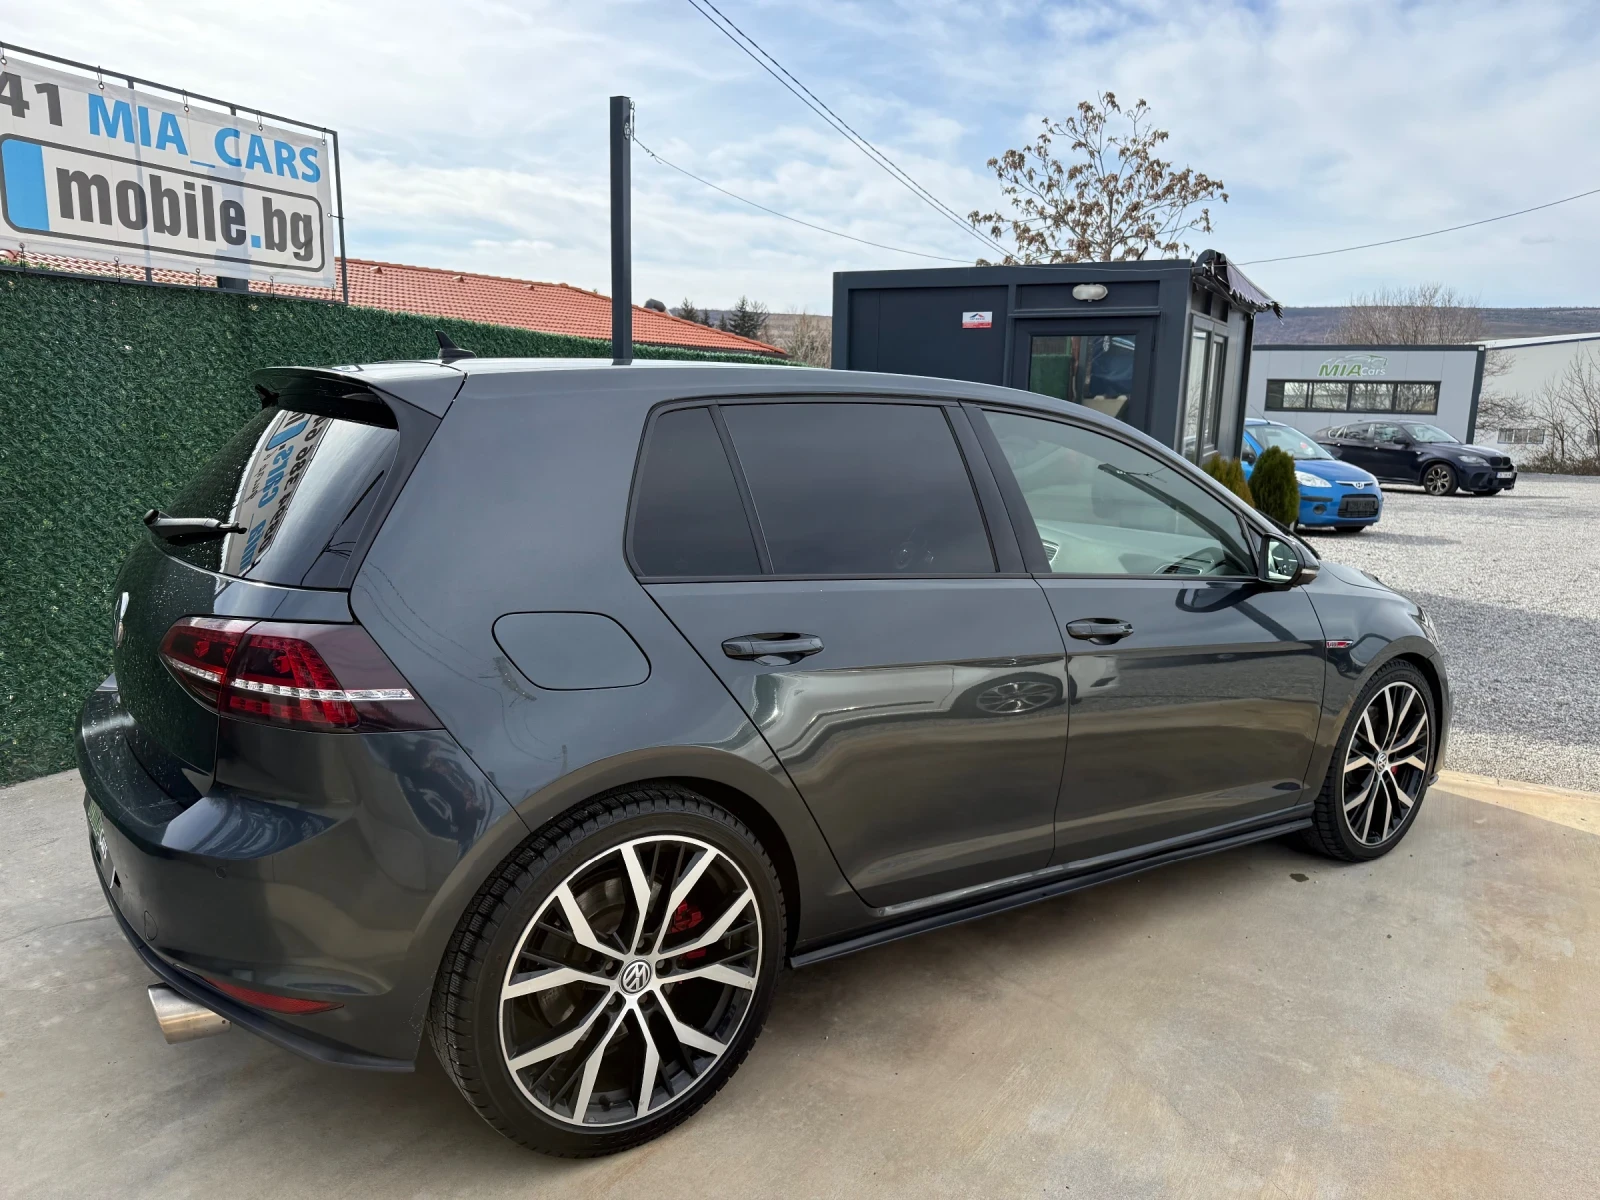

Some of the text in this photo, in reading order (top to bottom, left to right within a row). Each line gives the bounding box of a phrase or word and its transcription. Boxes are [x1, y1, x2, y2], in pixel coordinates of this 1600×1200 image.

[88, 93, 321, 183] MIA_CARS
[56, 167, 314, 262] mobile.bg
[1318, 364, 1386, 377] MIA Cars
